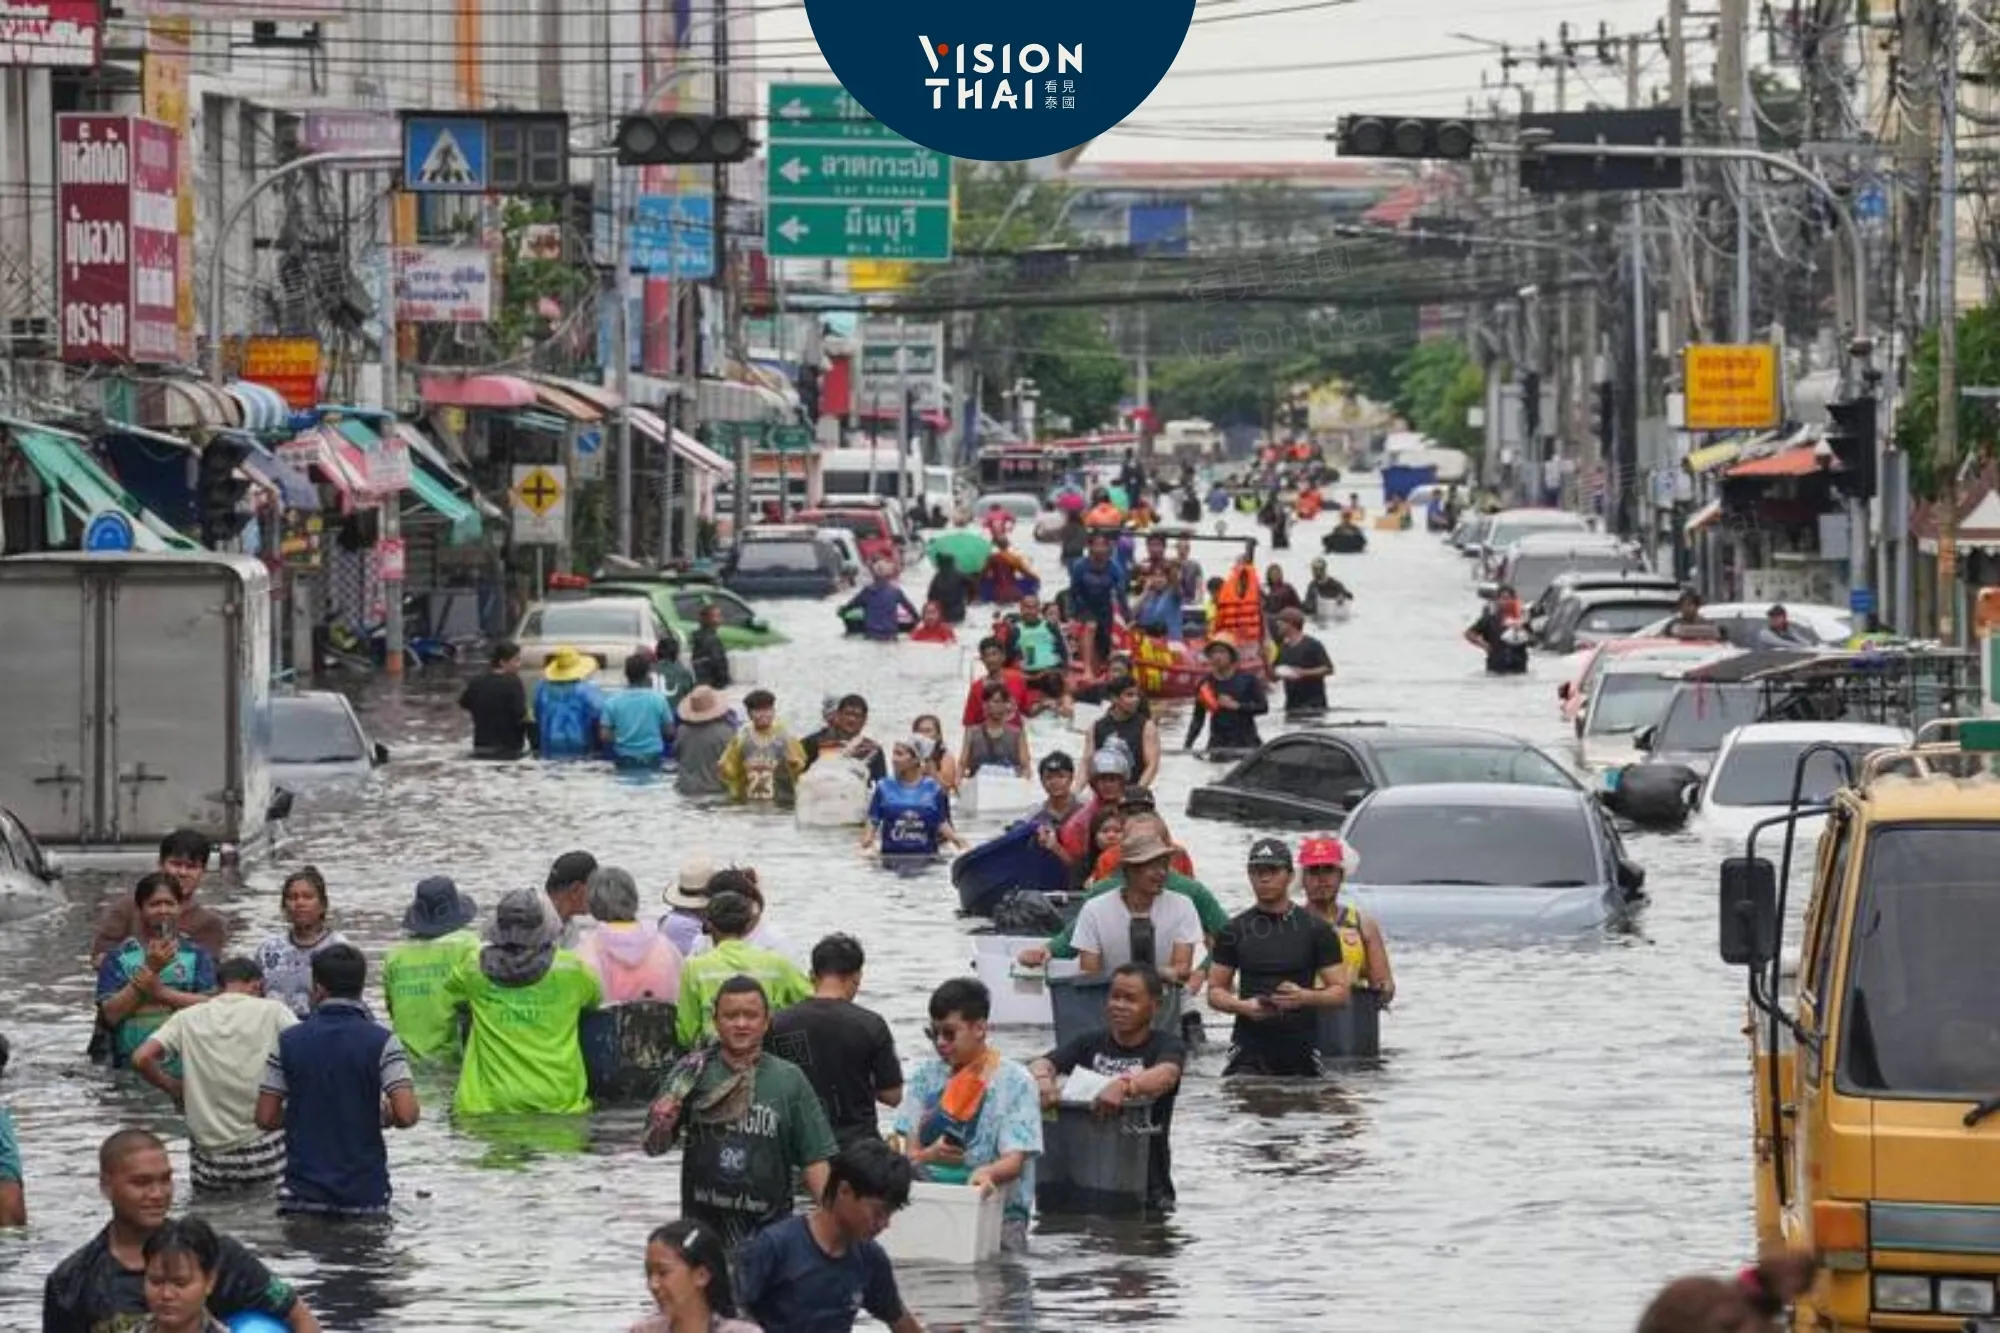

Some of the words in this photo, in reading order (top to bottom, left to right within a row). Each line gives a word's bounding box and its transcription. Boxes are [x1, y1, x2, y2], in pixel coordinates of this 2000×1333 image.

[821, 151, 939, 179] ลาดกระบัง
[845, 205, 917, 243] มีนบุรี
